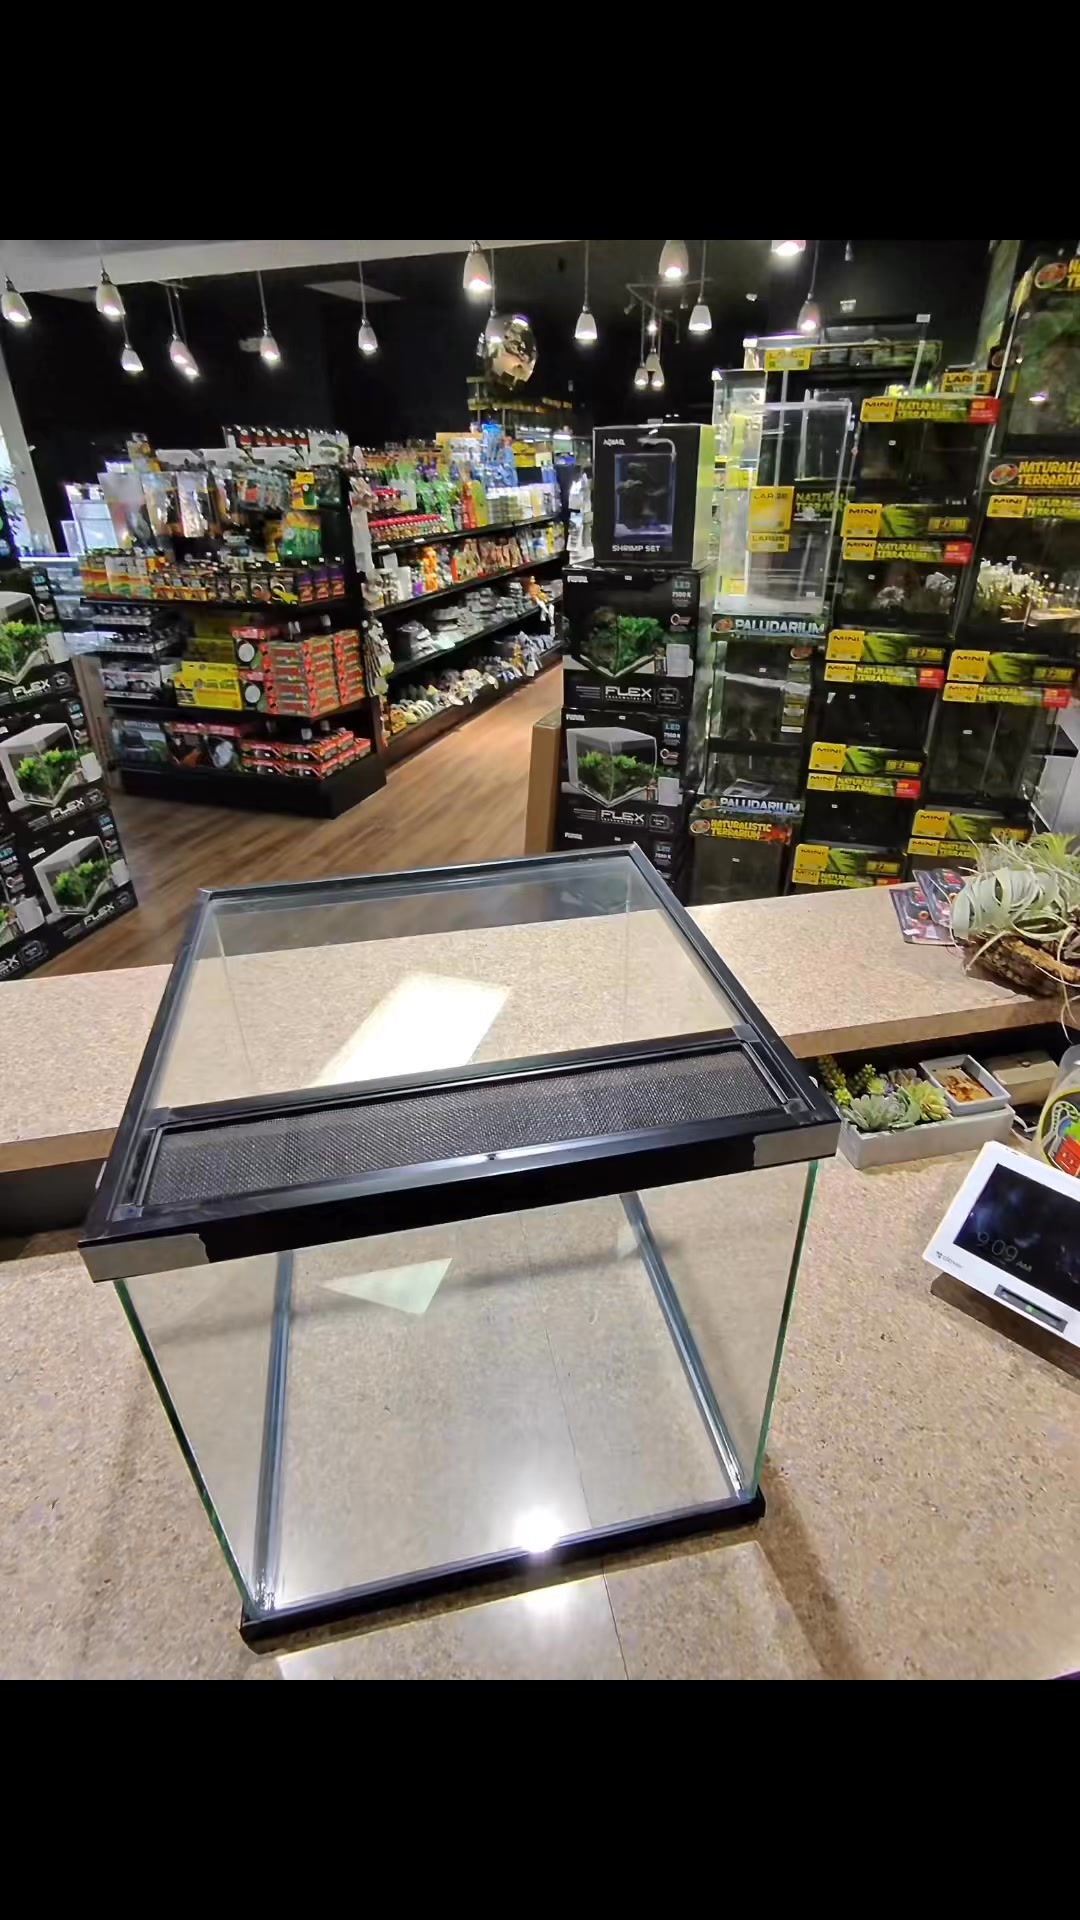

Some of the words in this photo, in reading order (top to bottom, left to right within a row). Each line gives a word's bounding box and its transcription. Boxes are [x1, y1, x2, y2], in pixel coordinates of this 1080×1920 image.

[877, 543, 918, 551] NATURAL
[735, 619, 825, 634] PALUDARIUM
[12, 679, 51, 697] FLEX
[605, 686, 652, 698] FLEX
[665, 722, 681, 731] LED
[50, 797, 85, 818] FLEX
[720, 797, 801, 813] PALUDARIUM
[600, 809, 645, 822] FLEX
[711, 819, 772, 832] NATURALISTIC
[712, 827, 761, 840] TERRARIUM
[83, 902, 116, 925] FLEX
